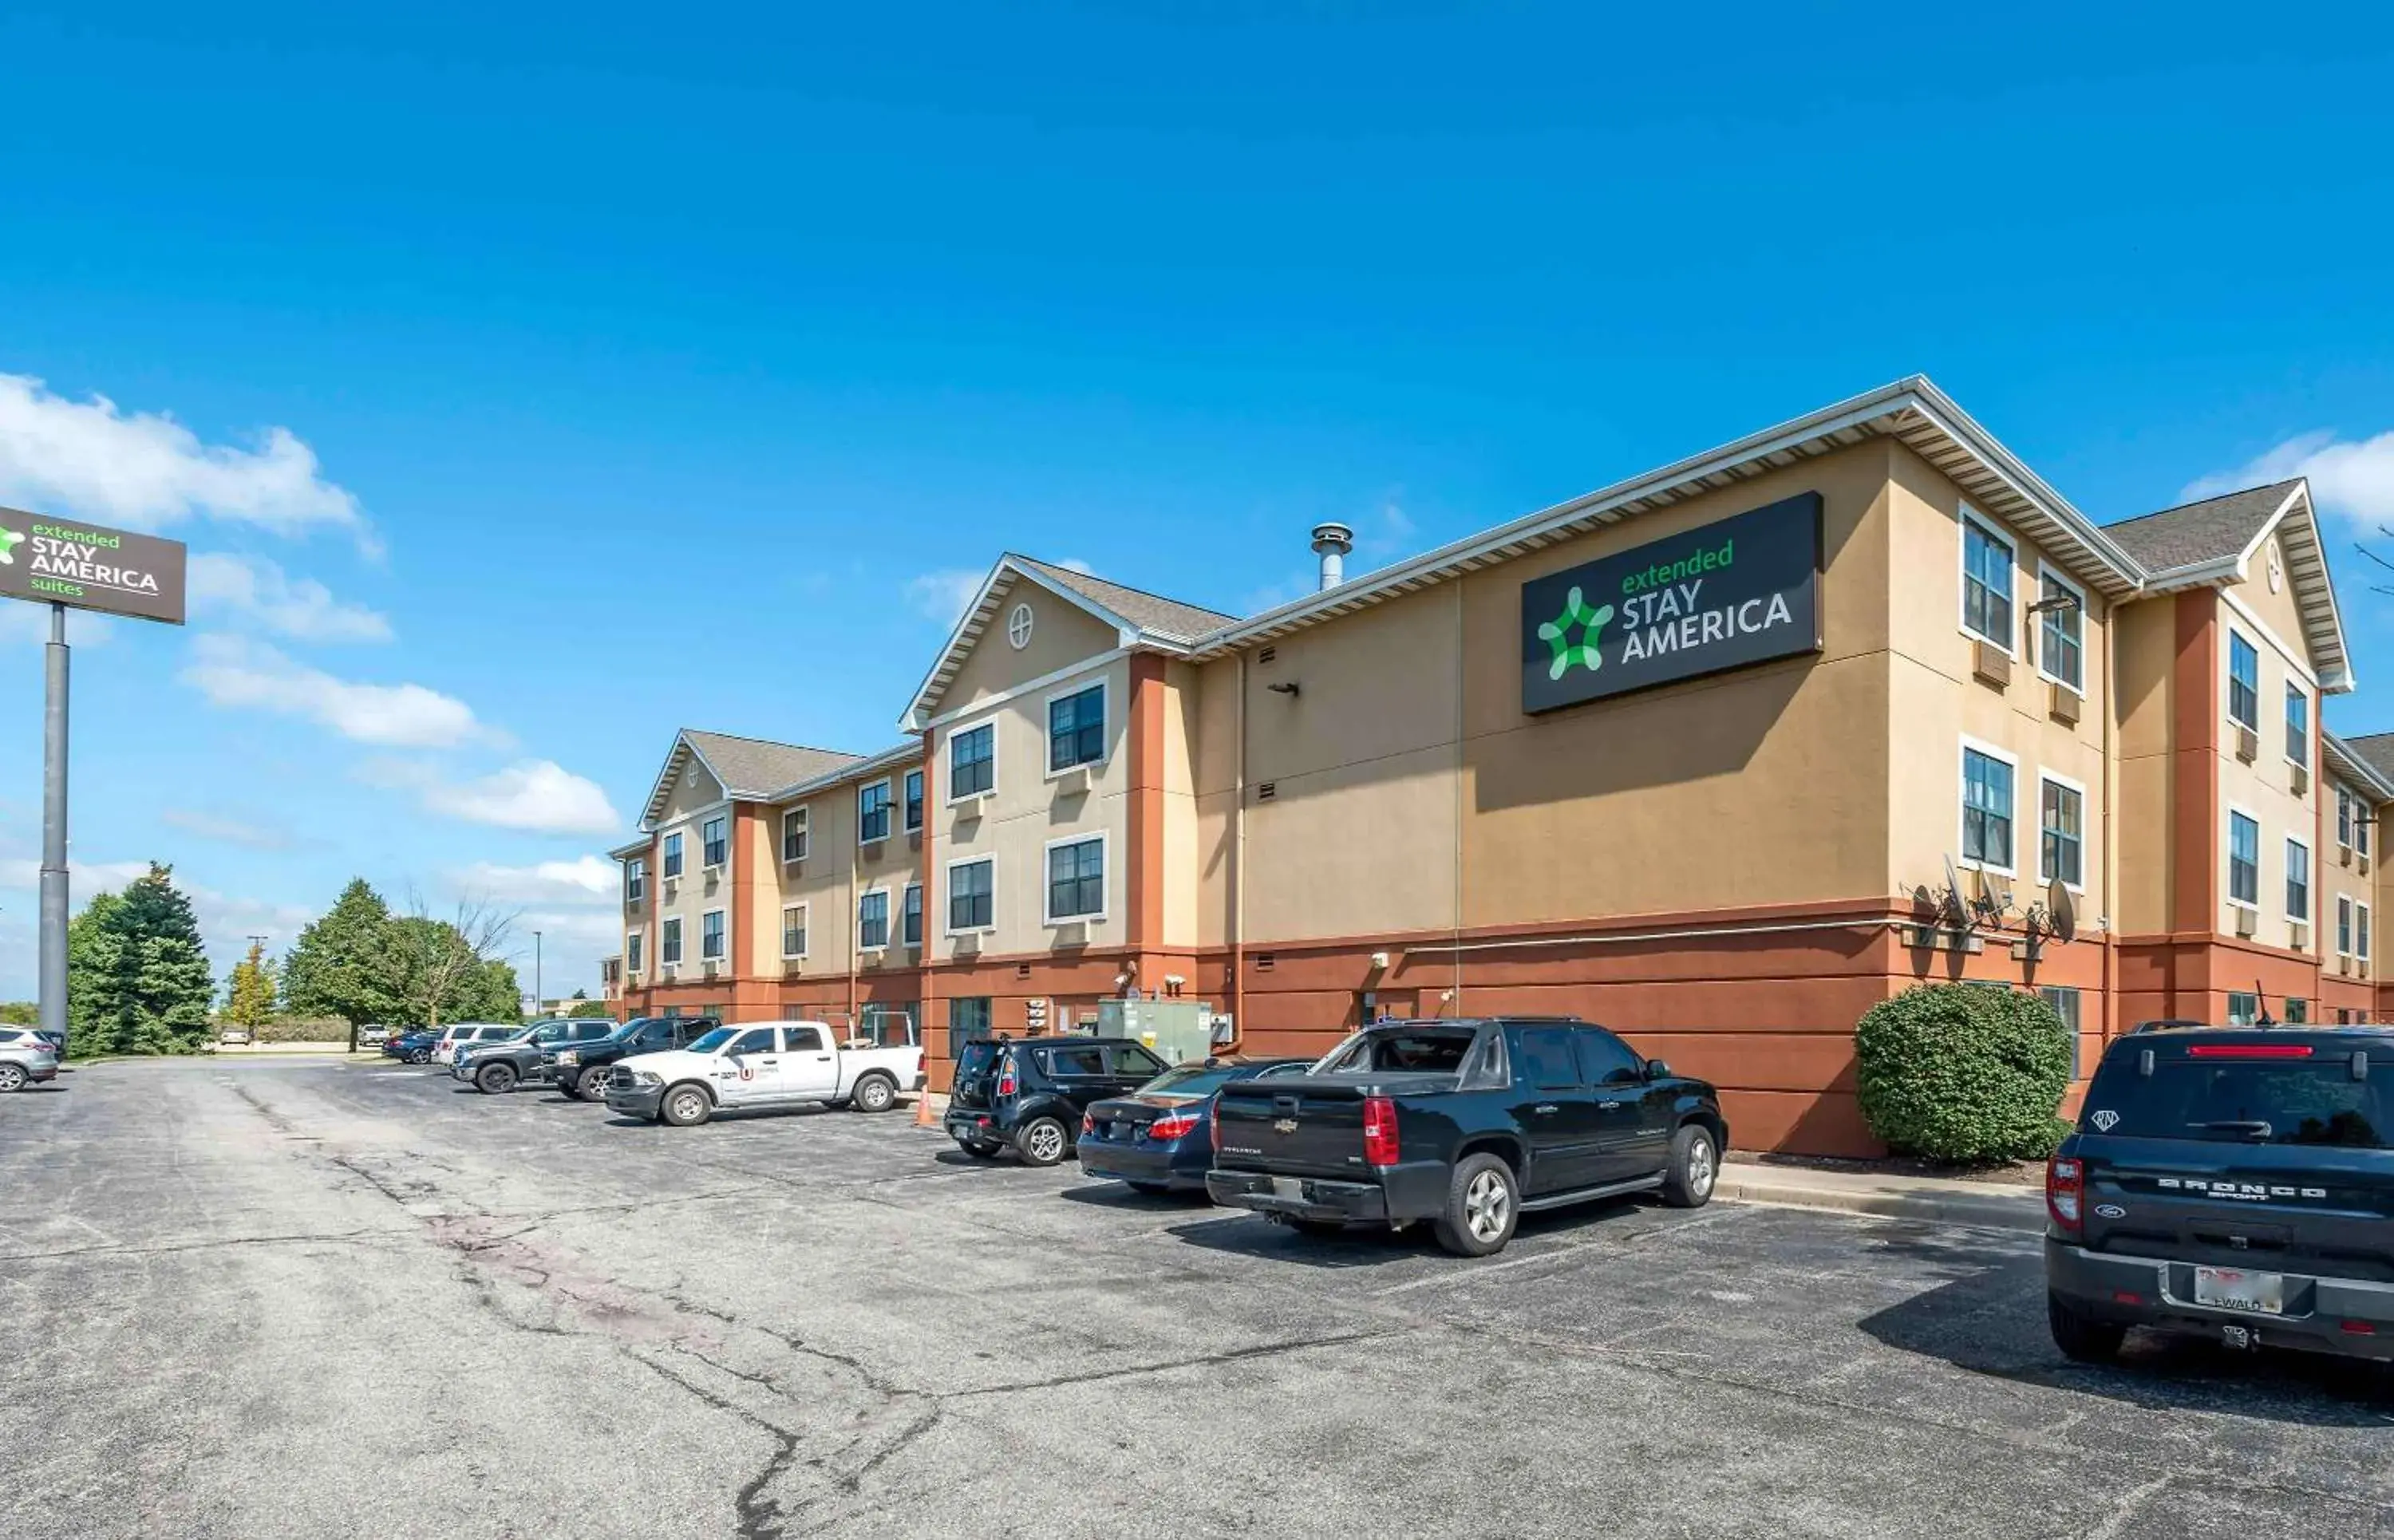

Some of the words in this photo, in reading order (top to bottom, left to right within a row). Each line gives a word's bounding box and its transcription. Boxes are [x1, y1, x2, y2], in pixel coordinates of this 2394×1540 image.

[31, 536, 97, 562] STAY
[33, 524, 120, 549] extended
[30, 555, 159, 590] AMERICA
[1622, 539, 1733, 594] extended
[30, 578, 85, 596] suites
[1622, 579, 1703, 630] STAY
[1622, 593, 1792, 665] AMERICA
[2158, 1178, 2327, 1198] BRONCO
